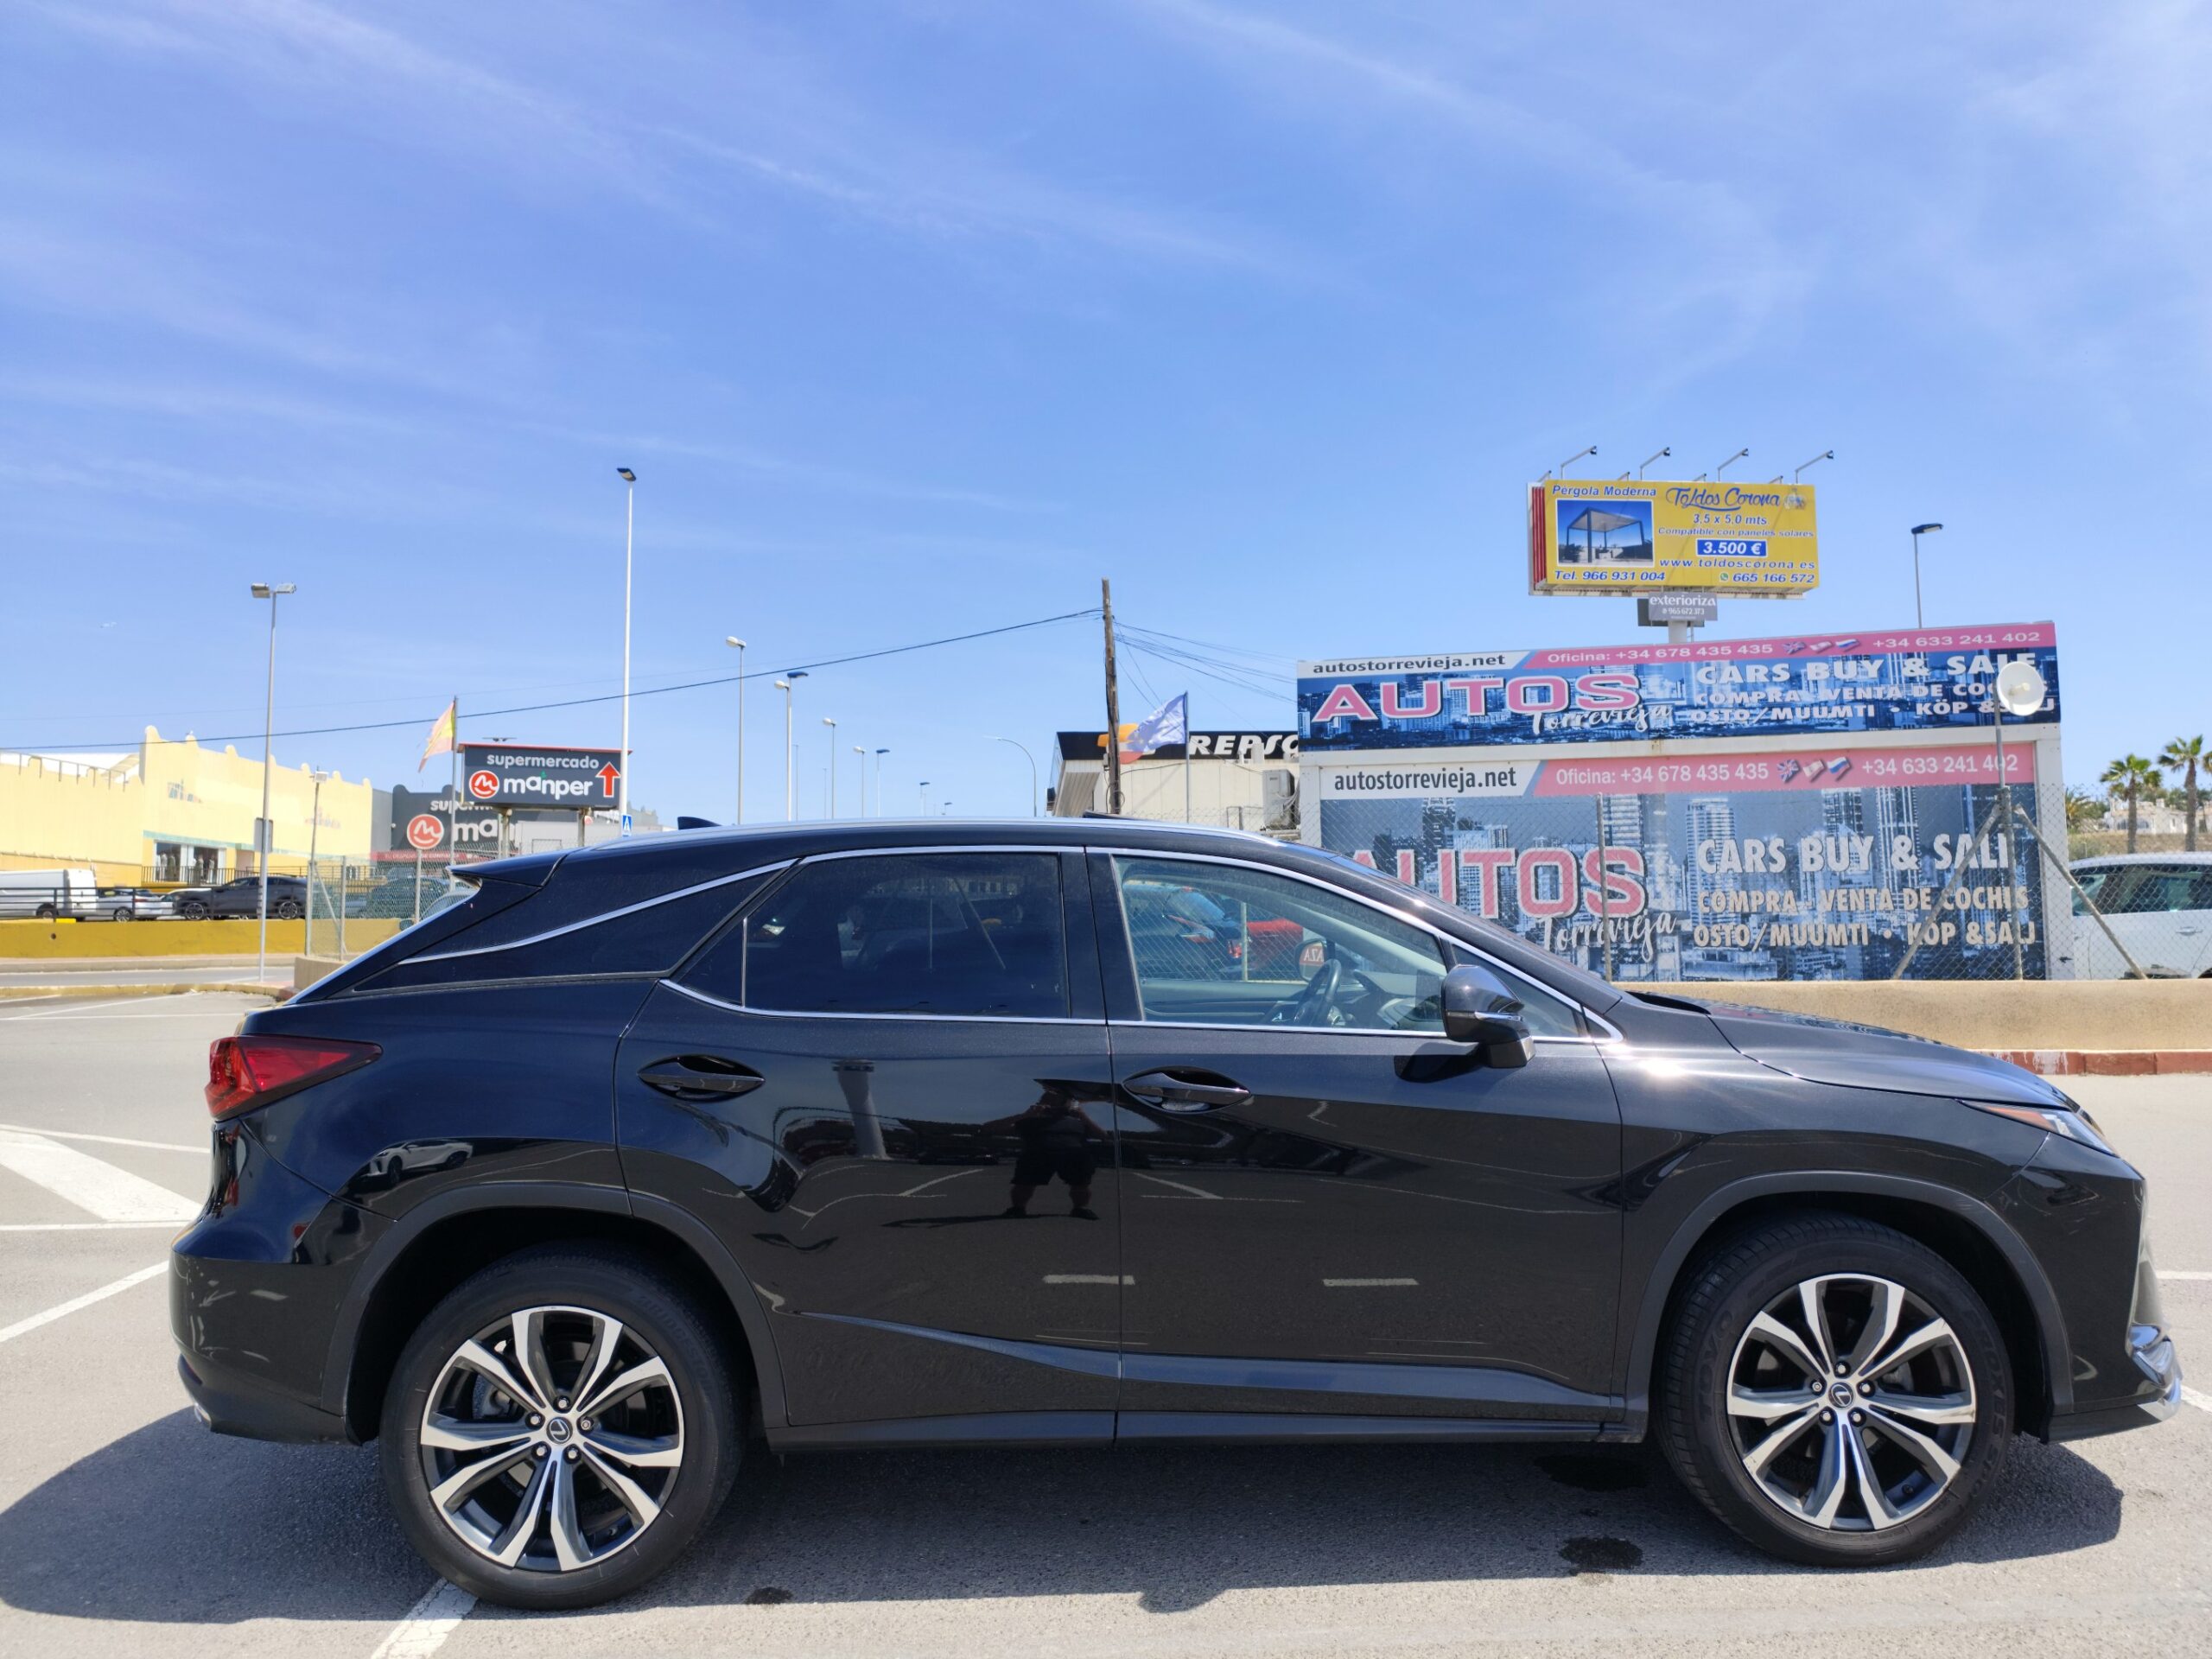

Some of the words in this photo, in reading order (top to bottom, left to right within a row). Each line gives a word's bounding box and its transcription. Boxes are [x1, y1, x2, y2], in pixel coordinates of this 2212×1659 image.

[1604, 486, 1656, 496] Moderna
[1666, 487, 1728, 510] Toldos
[1725, 487, 1780, 506] Corona
[1658, 527, 1714, 537] Compatible
[1738, 528, 1776, 537] paneles
[1778, 529, 1814, 537] solares
[1702, 542, 1747, 555] 3.500
[1751, 543, 1762, 555] €
[1660, 559, 1815, 569] www.toldoscorona.es
[1555, 570, 1577, 581] Tel.
[1582, 571, 1607, 581] 966
[1611, 571, 1636, 581] 931
[1640, 571, 1666, 582] 004
[1732, 573, 1758, 582] 665
[1764, 573, 1786, 583] 166
[1789, 574, 1815, 583] 572
[1649, 594, 1716, 606] exterioriza
[1873, 638, 1910, 648] +34
[1916, 636, 1953, 647] 633
[1959, 634, 1996, 645] 241
[2001, 632, 2040, 643] 402
[1313, 654, 1506, 674] autostorrevieja.net
[1548, 651, 1611, 664] Oficina:
[1616, 650, 1650, 659] +34
[1656, 648, 1691, 658] 678
[1696, 645, 1732, 657] 435
[1737, 644, 1773, 655] 435
[1696, 663, 1791, 685] CARS
[1806, 659, 1885, 681] BUY
[1903, 658, 1930, 677] &
[1311, 673, 1640, 723] AUTOS
[1694, 690, 1801, 706] COMPRA
[1822, 684, 1903, 701] VENTA
[1912, 683, 1943, 697] DE
[1916, 699, 1968, 715] KÖP
[1525, 704, 1673, 735] Torrevieja
[486, 754, 600, 769] supermercado
[1862, 759, 1897, 776] +34
[1903, 757, 1938, 774] 633
[1943, 755, 1978, 773] 241
[1982, 754, 2018, 772] 402
[1334, 766, 1517, 793] autostorrevieja.net
[1556, 768, 1616, 785] Oficina:
[1621, 766, 1654, 783] +34
[1658, 765, 1692, 782] 678
[1696, 764, 1730, 781] 435
[1734, 763, 1769, 779] 435
[503, 775, 594, 800] manper
[1698, 838, 1787, 874] CARS
[1801, 836, 1874, 873] BUY
[1891, 835, 1919, 870] &
[1698, 889, 1798, 914] COMPRA
[1820, 887, 1894, 912] VENTA
[1903, 887, 1932, 911] DE
[1699, 1310, 1734, 1422] TOYO
